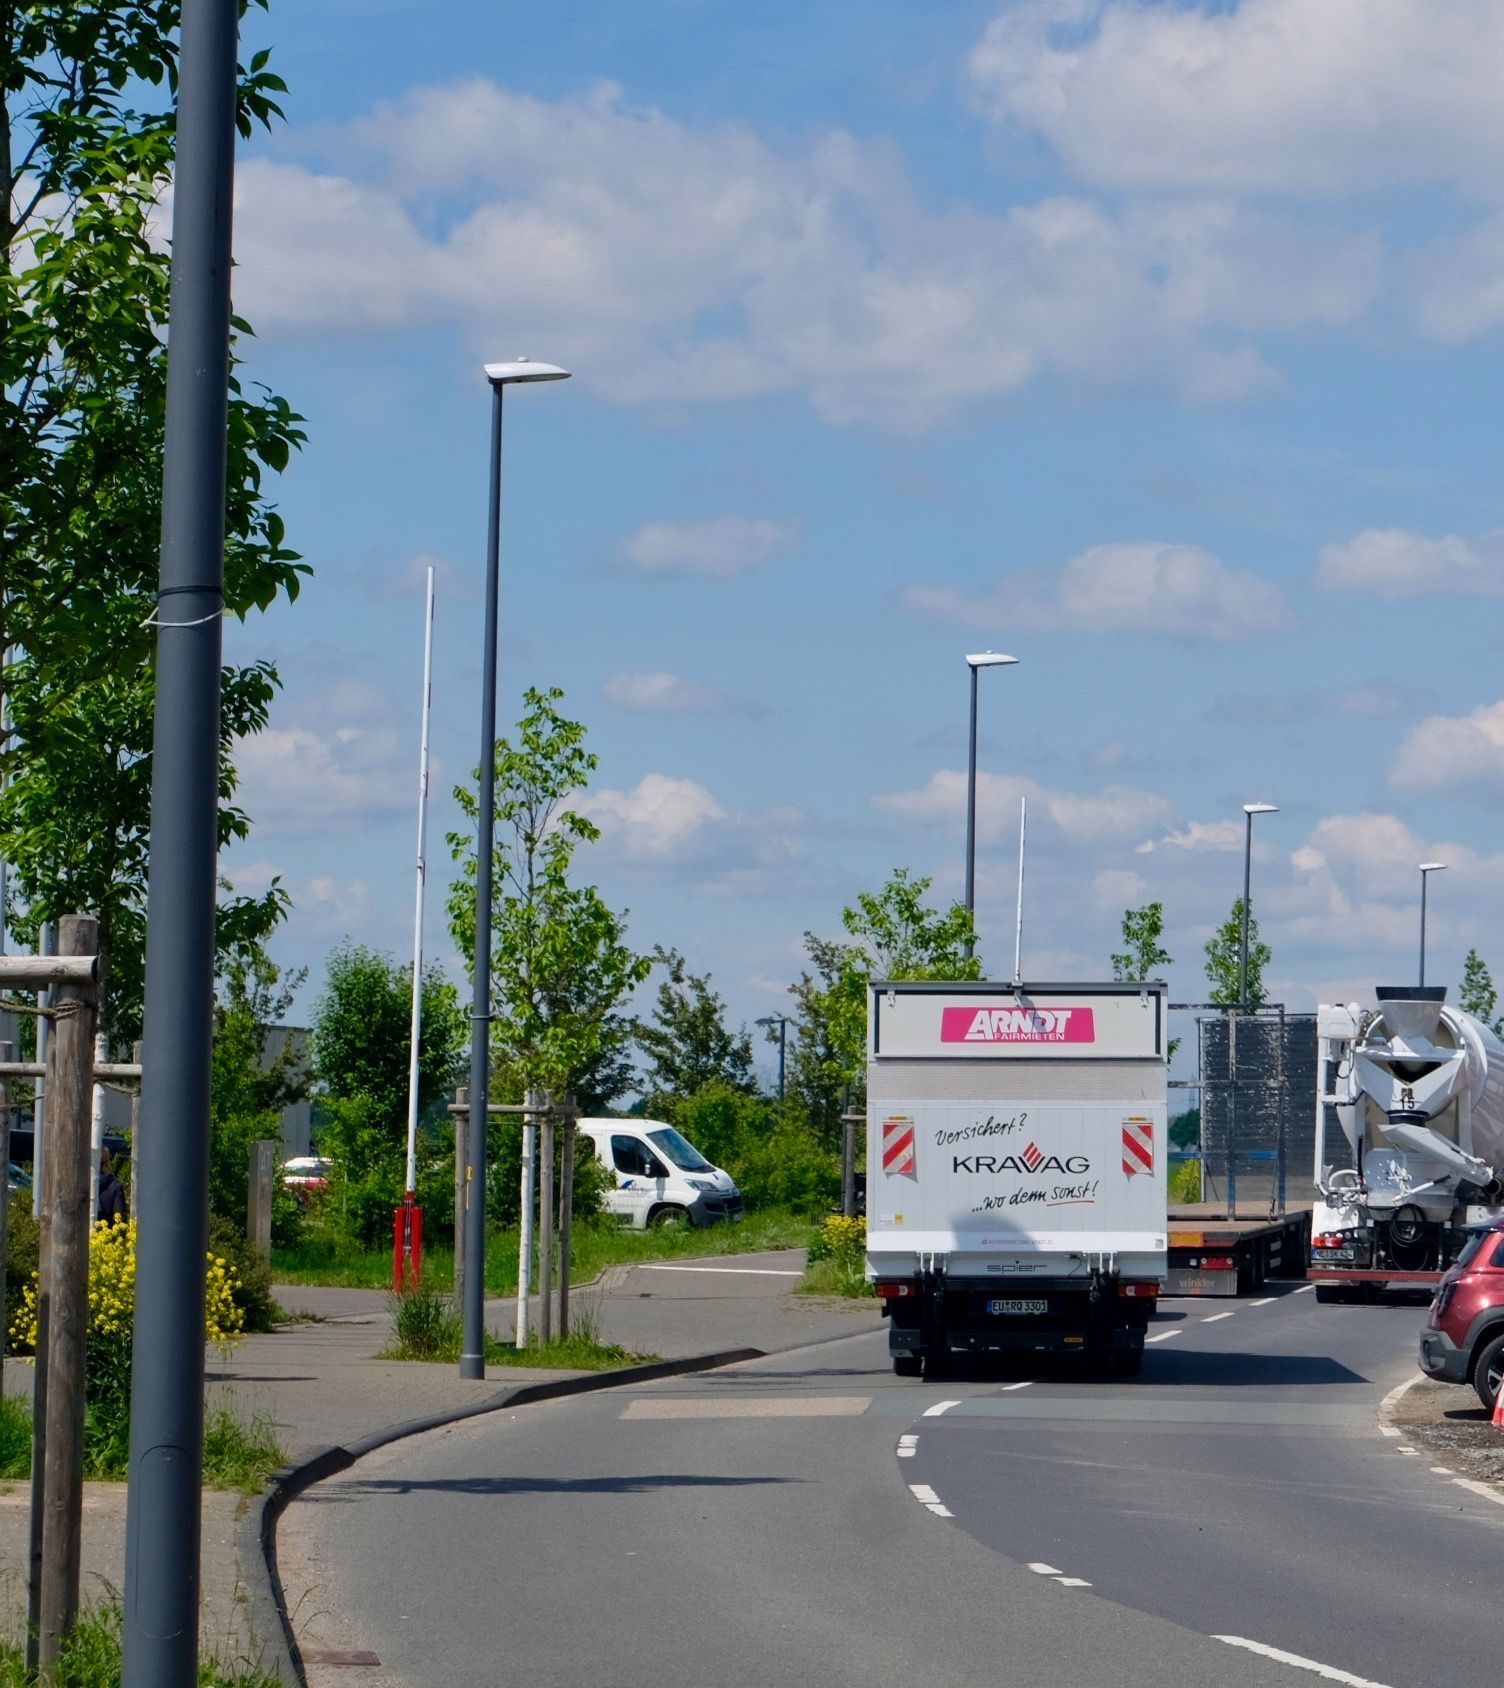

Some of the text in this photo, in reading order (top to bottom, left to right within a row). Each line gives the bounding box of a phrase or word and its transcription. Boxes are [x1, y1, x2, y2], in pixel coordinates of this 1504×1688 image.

[965, 1010, 1072, 1040] ARNDT
[995, 1033, 1065, 1041] FAIRMIETEN
[1400, 1096, 1415, 1110] 15
[953, 1155, 1090, 1174] KRAVAG
[1009, 1187, 1047, 1206] denn
[1050, 1180, 1099, 1200] sonst!
[987, 1260, 1048, 1274] spier
[1180, 1278, 1216, 1288] winkler
[992, 1301, 1005, 1312] EU
[1024, 1301, 1047, 1312] 3301
